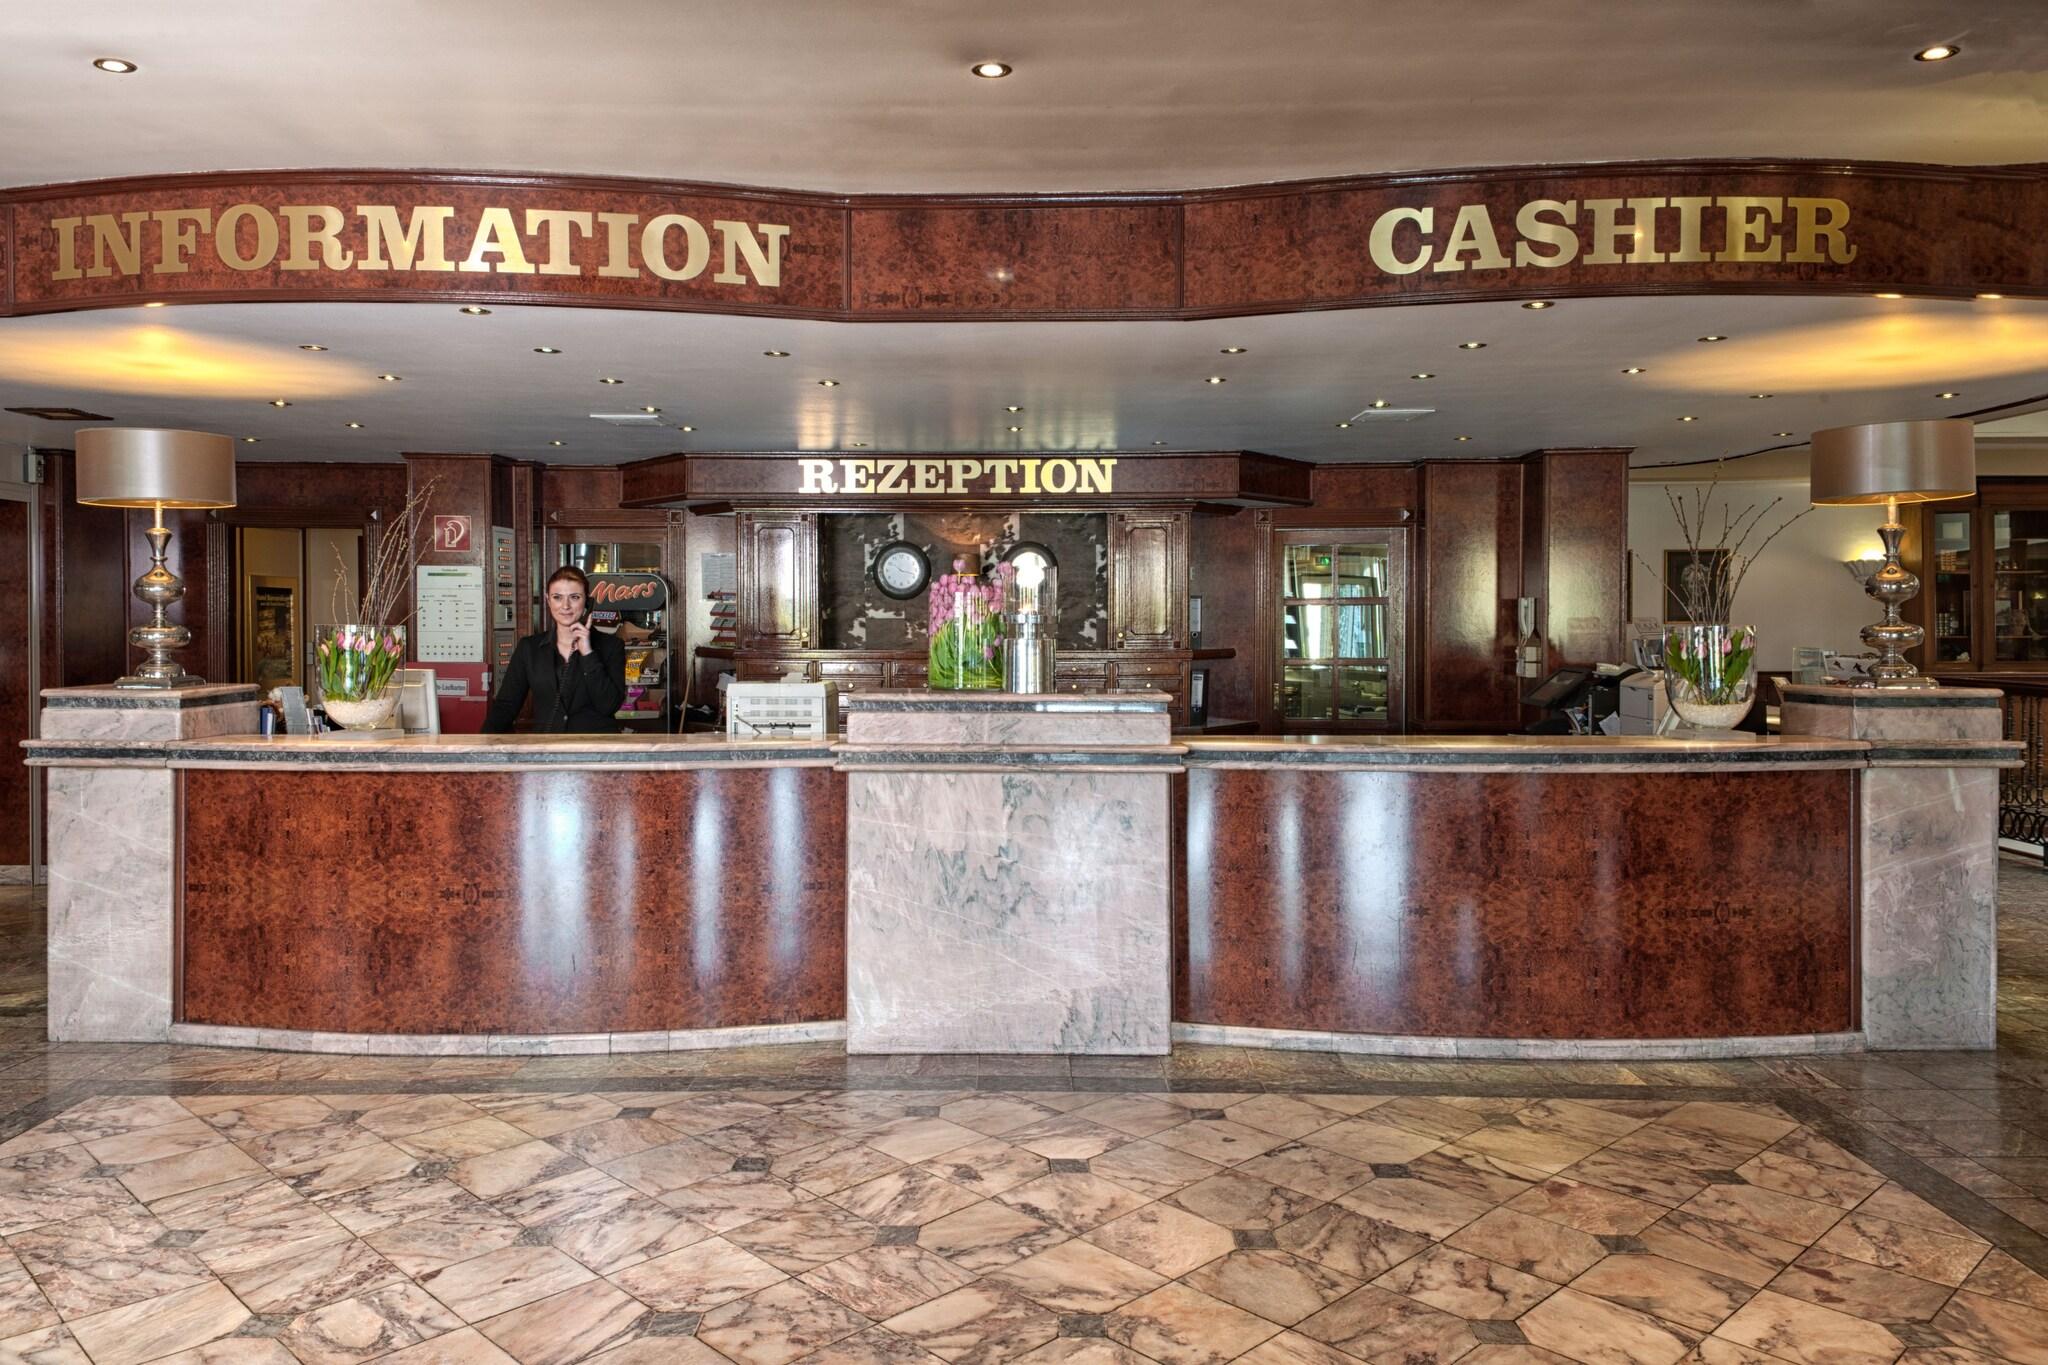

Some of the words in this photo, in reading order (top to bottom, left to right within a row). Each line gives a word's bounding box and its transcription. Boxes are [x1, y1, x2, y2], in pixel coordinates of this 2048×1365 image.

[51, 203, 790, 288] INFORMATION
[1369, 196, 1858, 275] CASHIER
[798, 459, 1117, 493] REZEPTION
[590, 580, 657, 605] Mars
